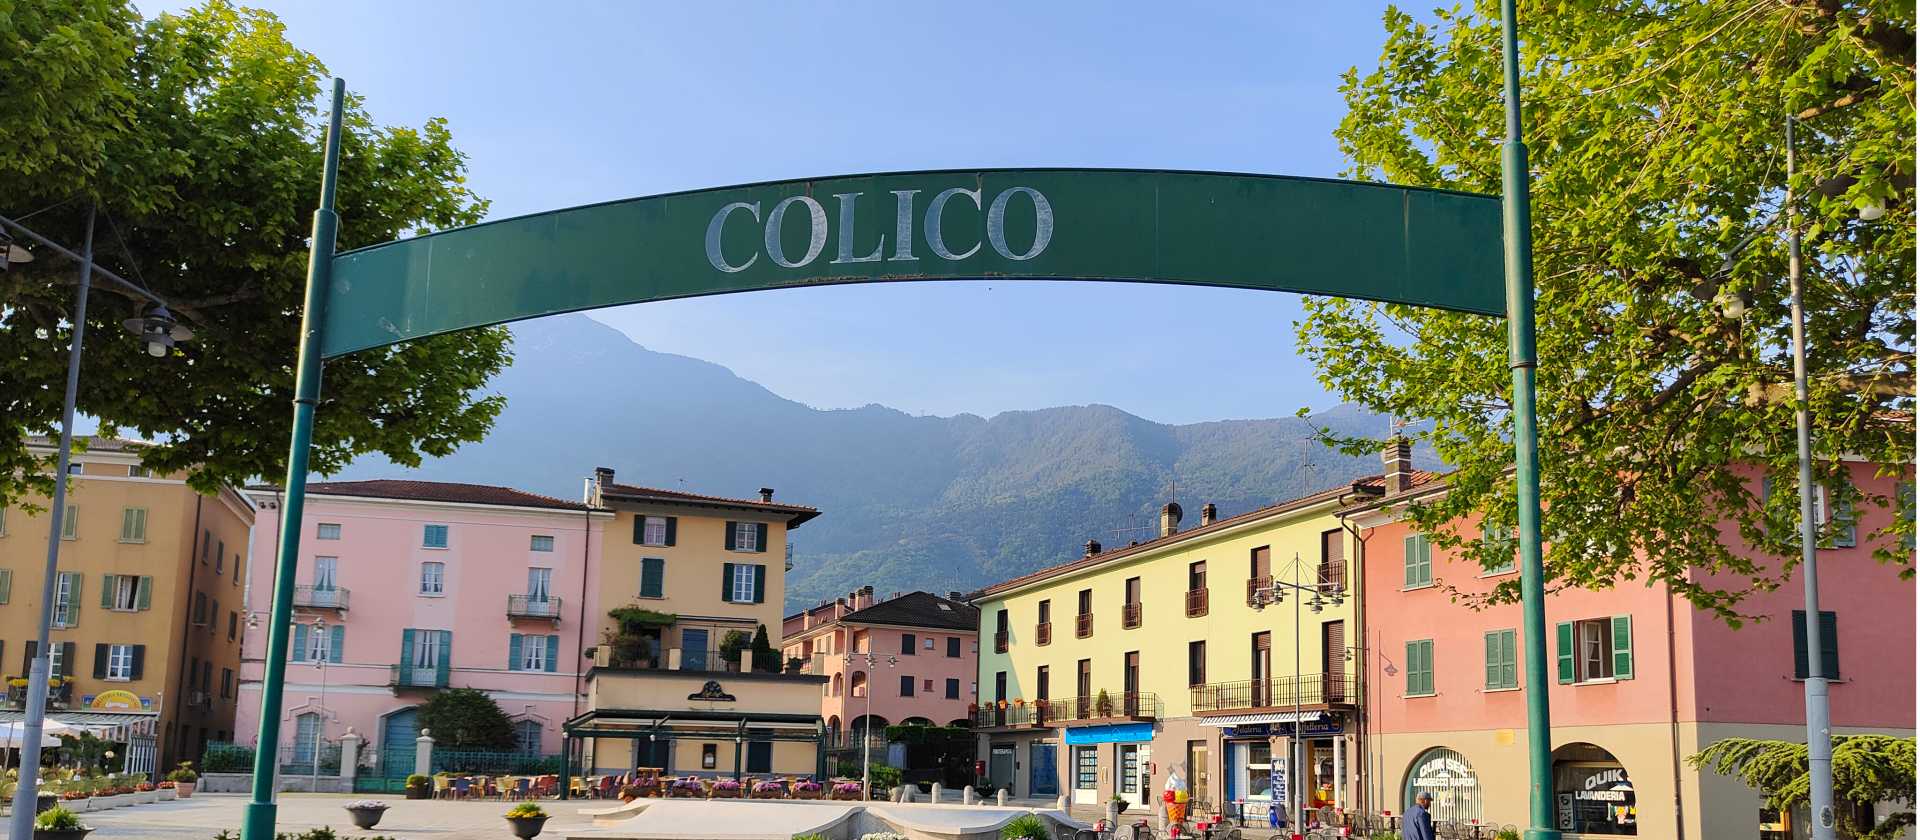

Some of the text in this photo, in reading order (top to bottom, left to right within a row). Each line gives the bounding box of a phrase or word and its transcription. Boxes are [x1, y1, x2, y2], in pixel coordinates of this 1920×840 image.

[704, 185, 1054, 273] COLICO
[1420, 758, 1446, 778] QUIK
[1585, 769, 1624, 790] QUIK
[1575, 790, 1625, 801] LAVANDERIA
